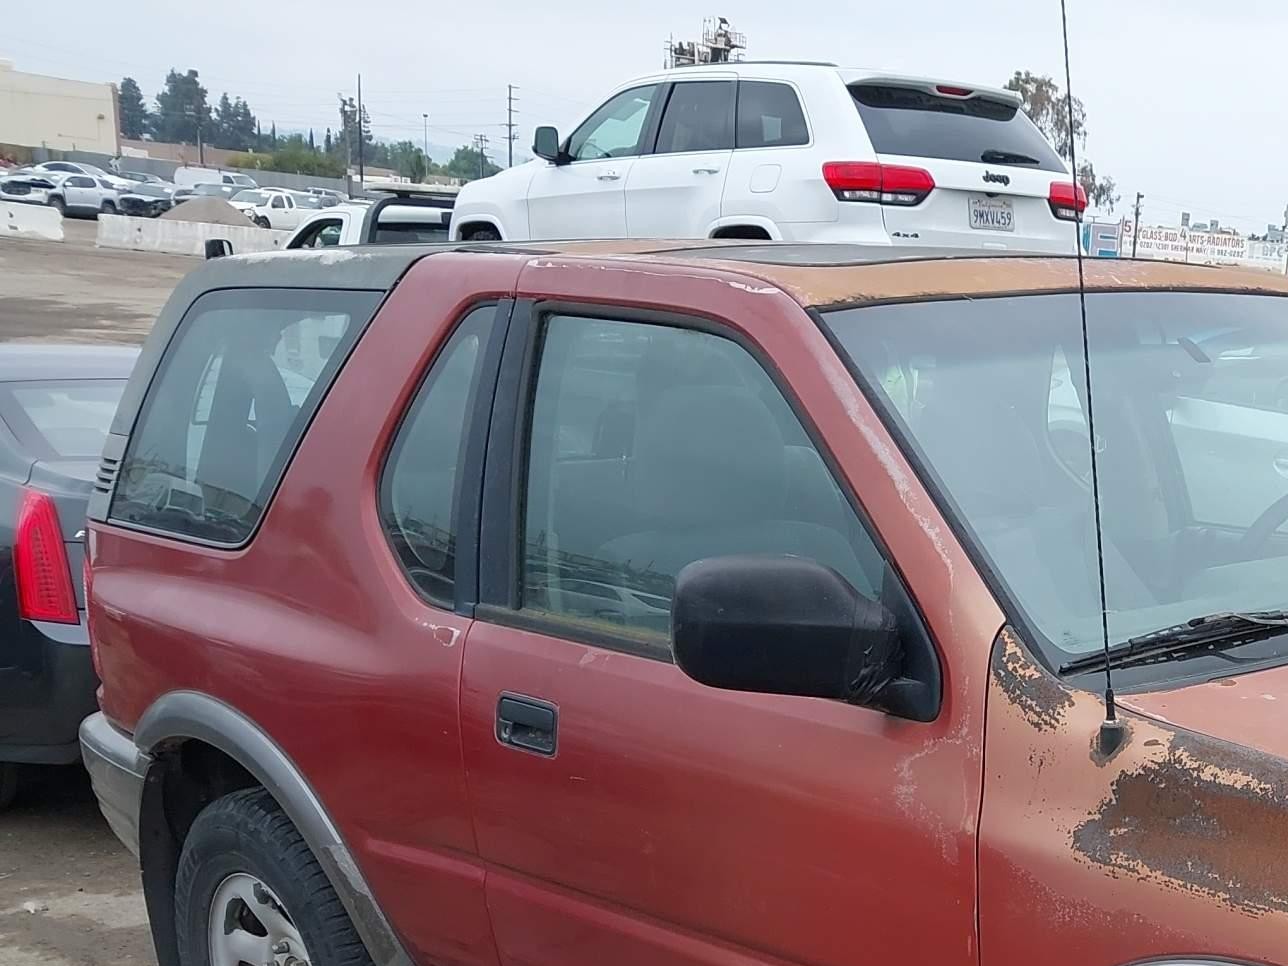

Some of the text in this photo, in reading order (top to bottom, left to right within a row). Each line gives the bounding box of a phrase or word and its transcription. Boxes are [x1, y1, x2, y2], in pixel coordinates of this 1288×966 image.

[983, 170, 1010, 186] Jeep
[973, 209, 1012, 226] 9MXV459
[1124, 220, 1132, 233] 5
[1179, 228, 1187, 241] 4
